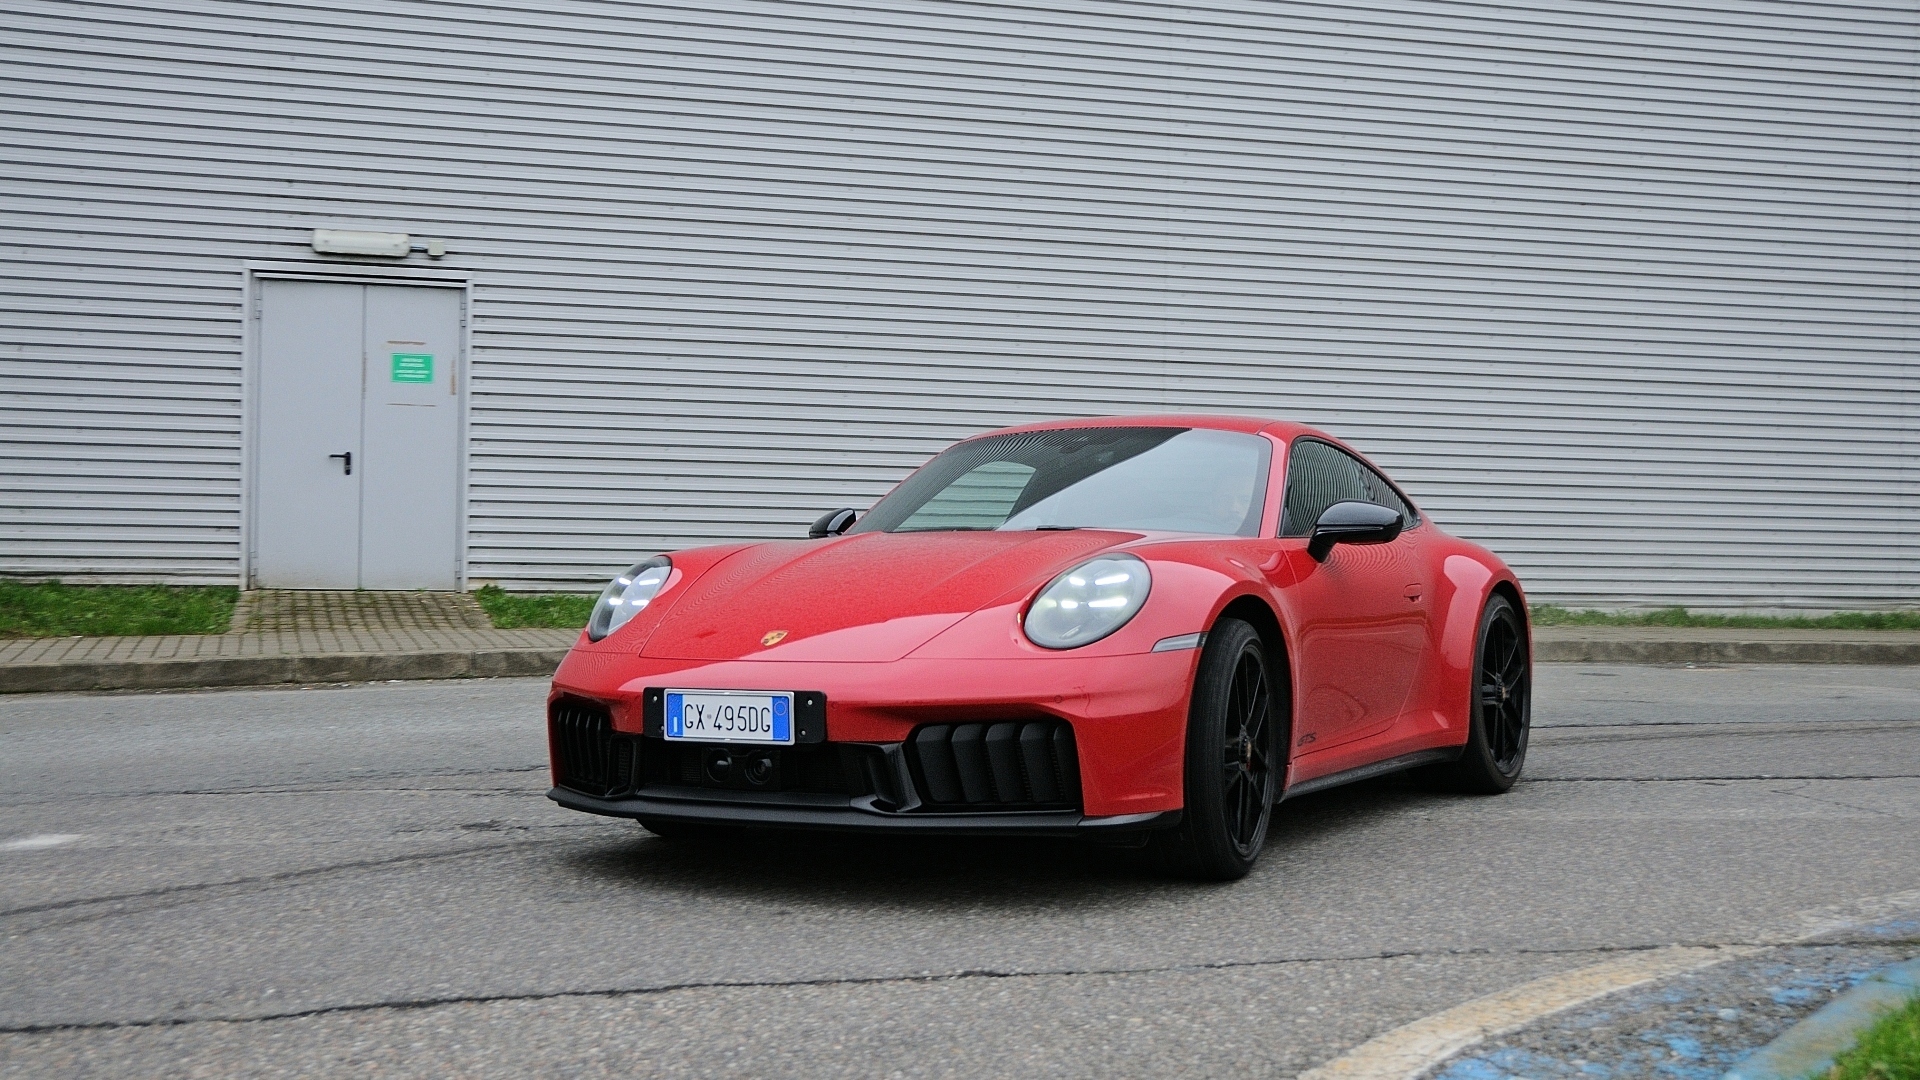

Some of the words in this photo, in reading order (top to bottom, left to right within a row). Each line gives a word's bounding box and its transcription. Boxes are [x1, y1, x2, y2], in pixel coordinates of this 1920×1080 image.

[684, 704, 705, 730] GX
[713, 705, 771, 733] 495DG
[1297, 732, 1316, 747] GTS
